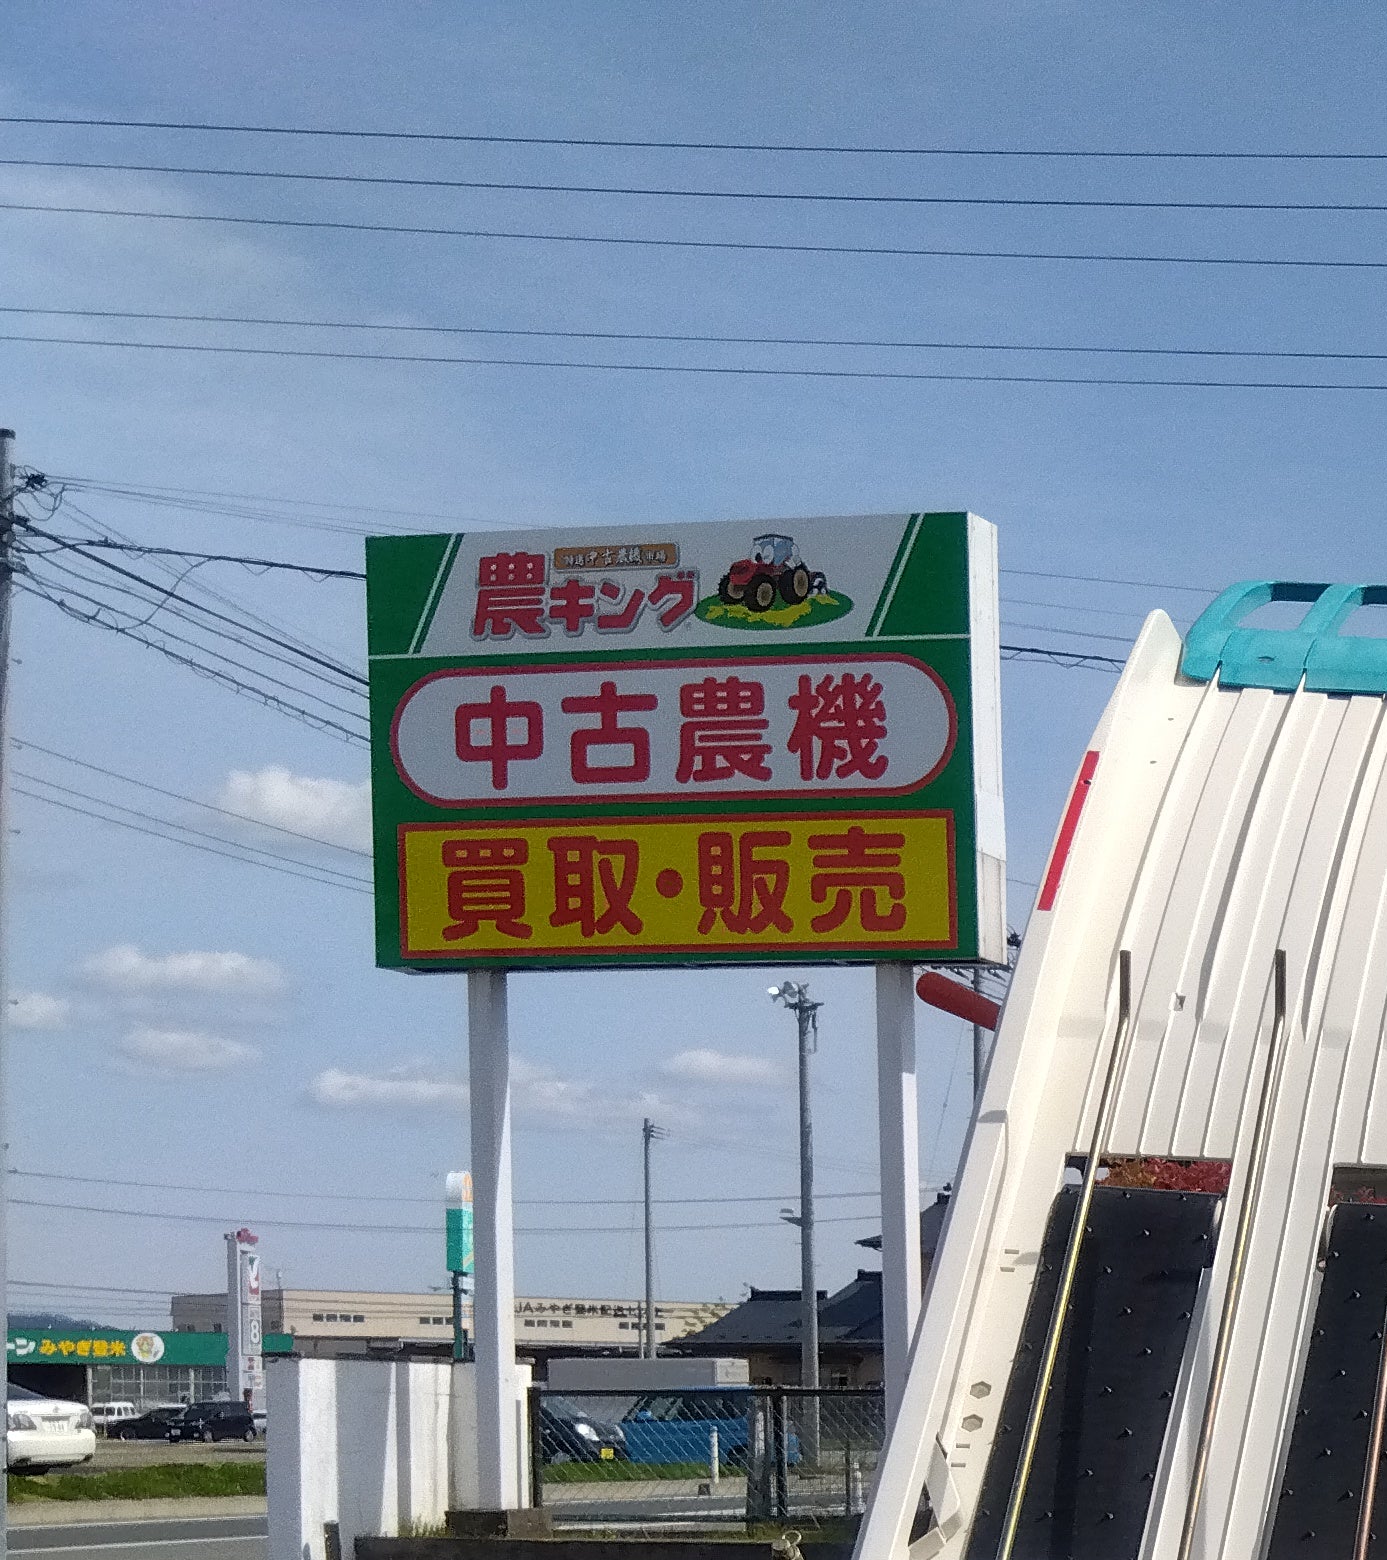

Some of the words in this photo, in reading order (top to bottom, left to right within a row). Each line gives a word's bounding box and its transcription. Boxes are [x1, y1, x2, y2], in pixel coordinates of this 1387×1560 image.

[473, 552, 695, 636] 農キング
[454, 673, 889, 791] 中古農機
[441, 825, 907, 941] 買取・販売
